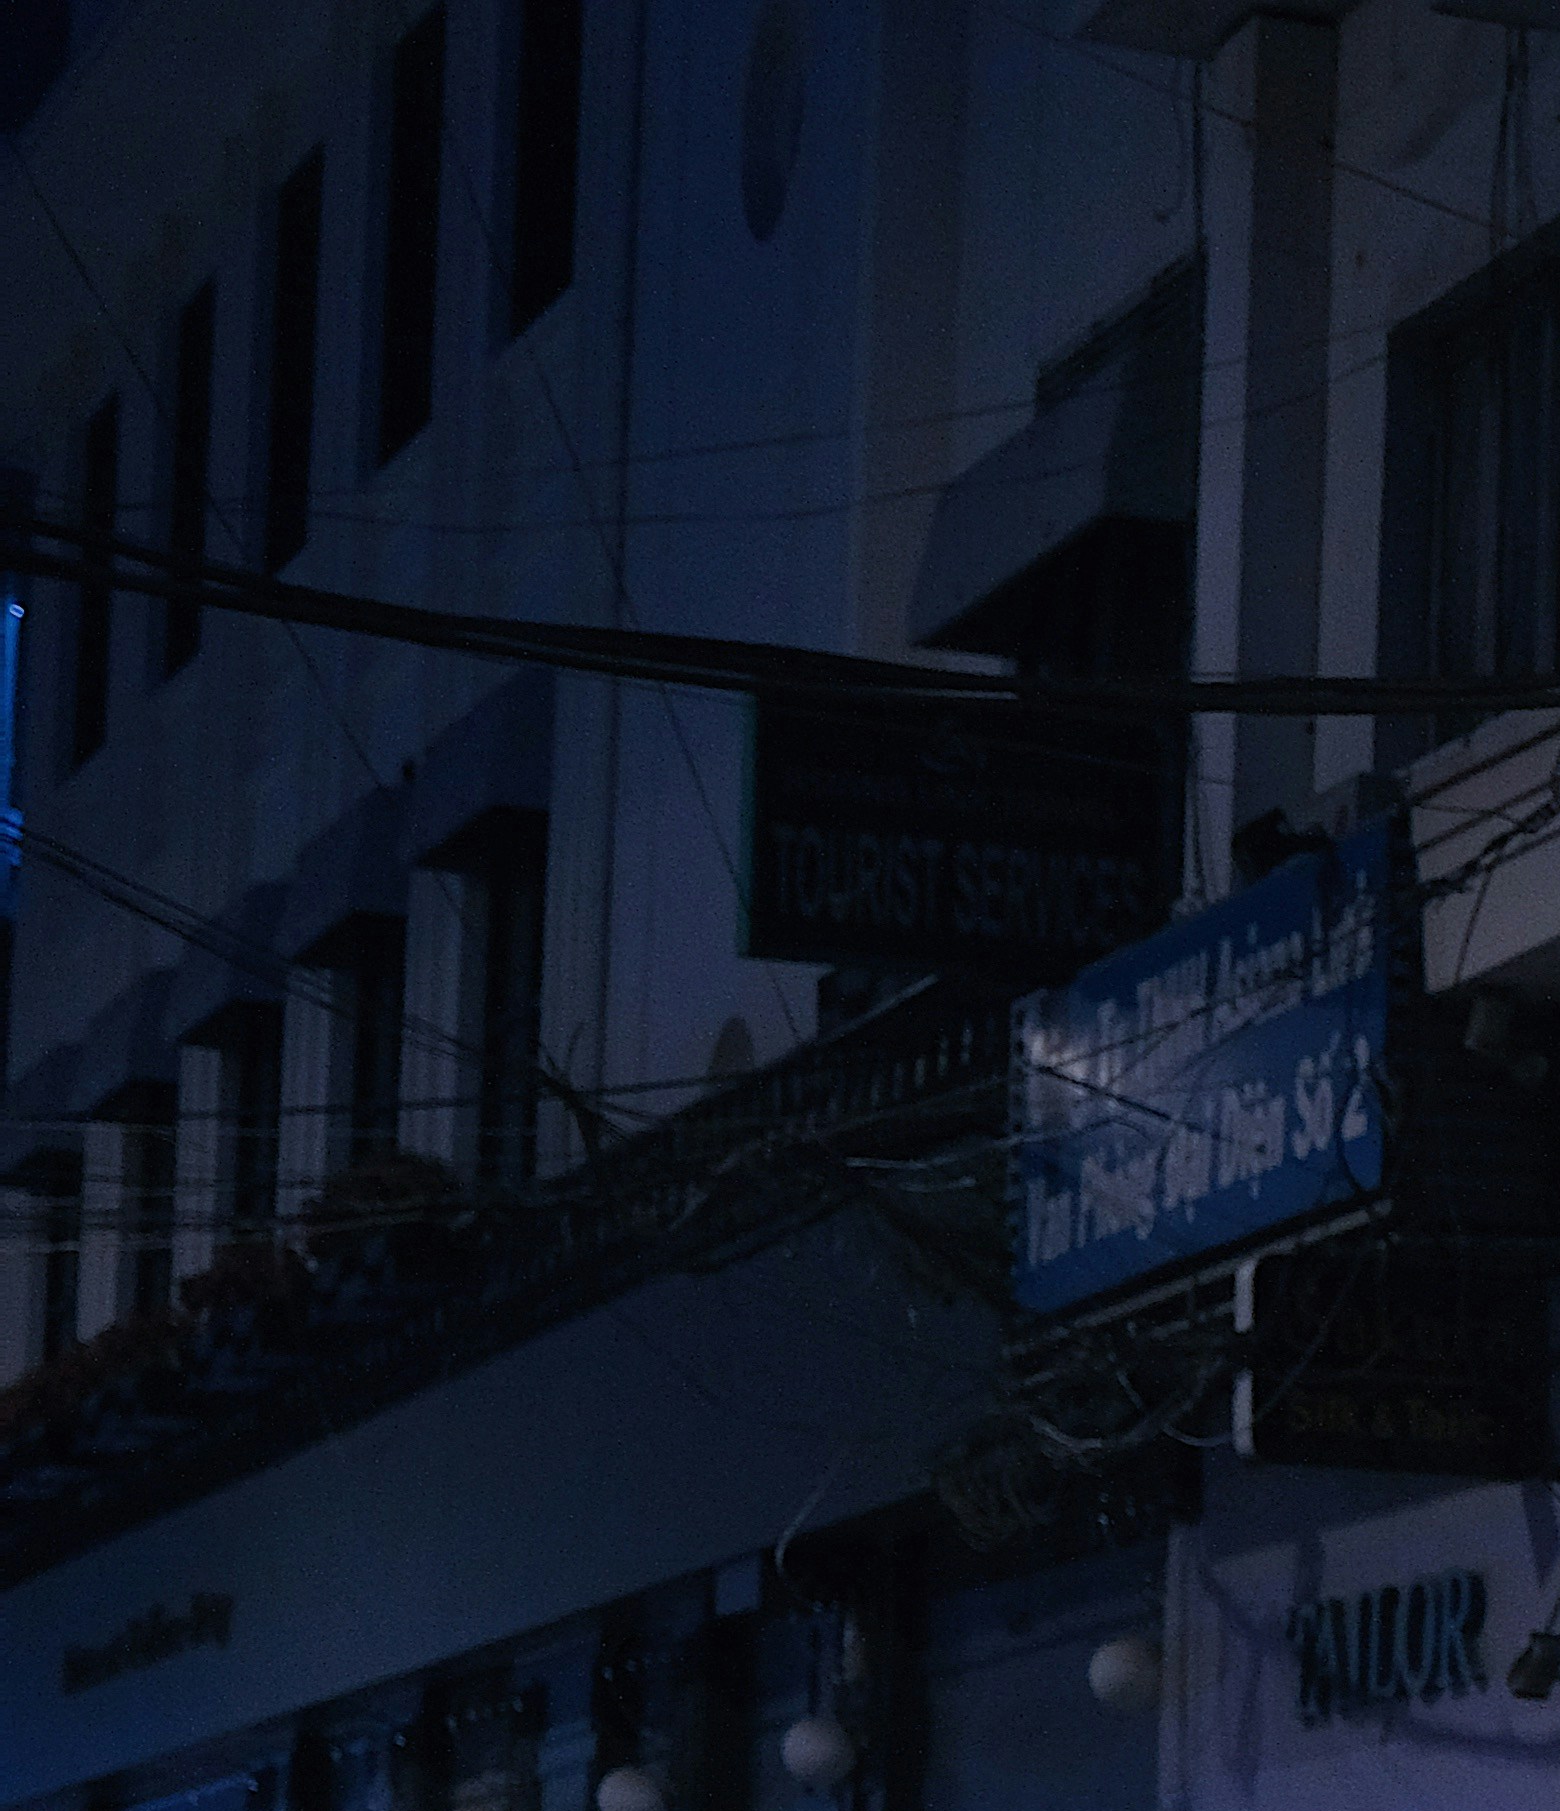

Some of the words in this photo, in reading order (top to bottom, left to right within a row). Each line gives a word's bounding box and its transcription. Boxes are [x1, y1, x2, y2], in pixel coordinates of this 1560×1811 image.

[772, 822, 945, 930] TOURIST
[1341, 1033, 1370, 1140] 2
[1284, 1566, 1486, 1720] TAILOR
